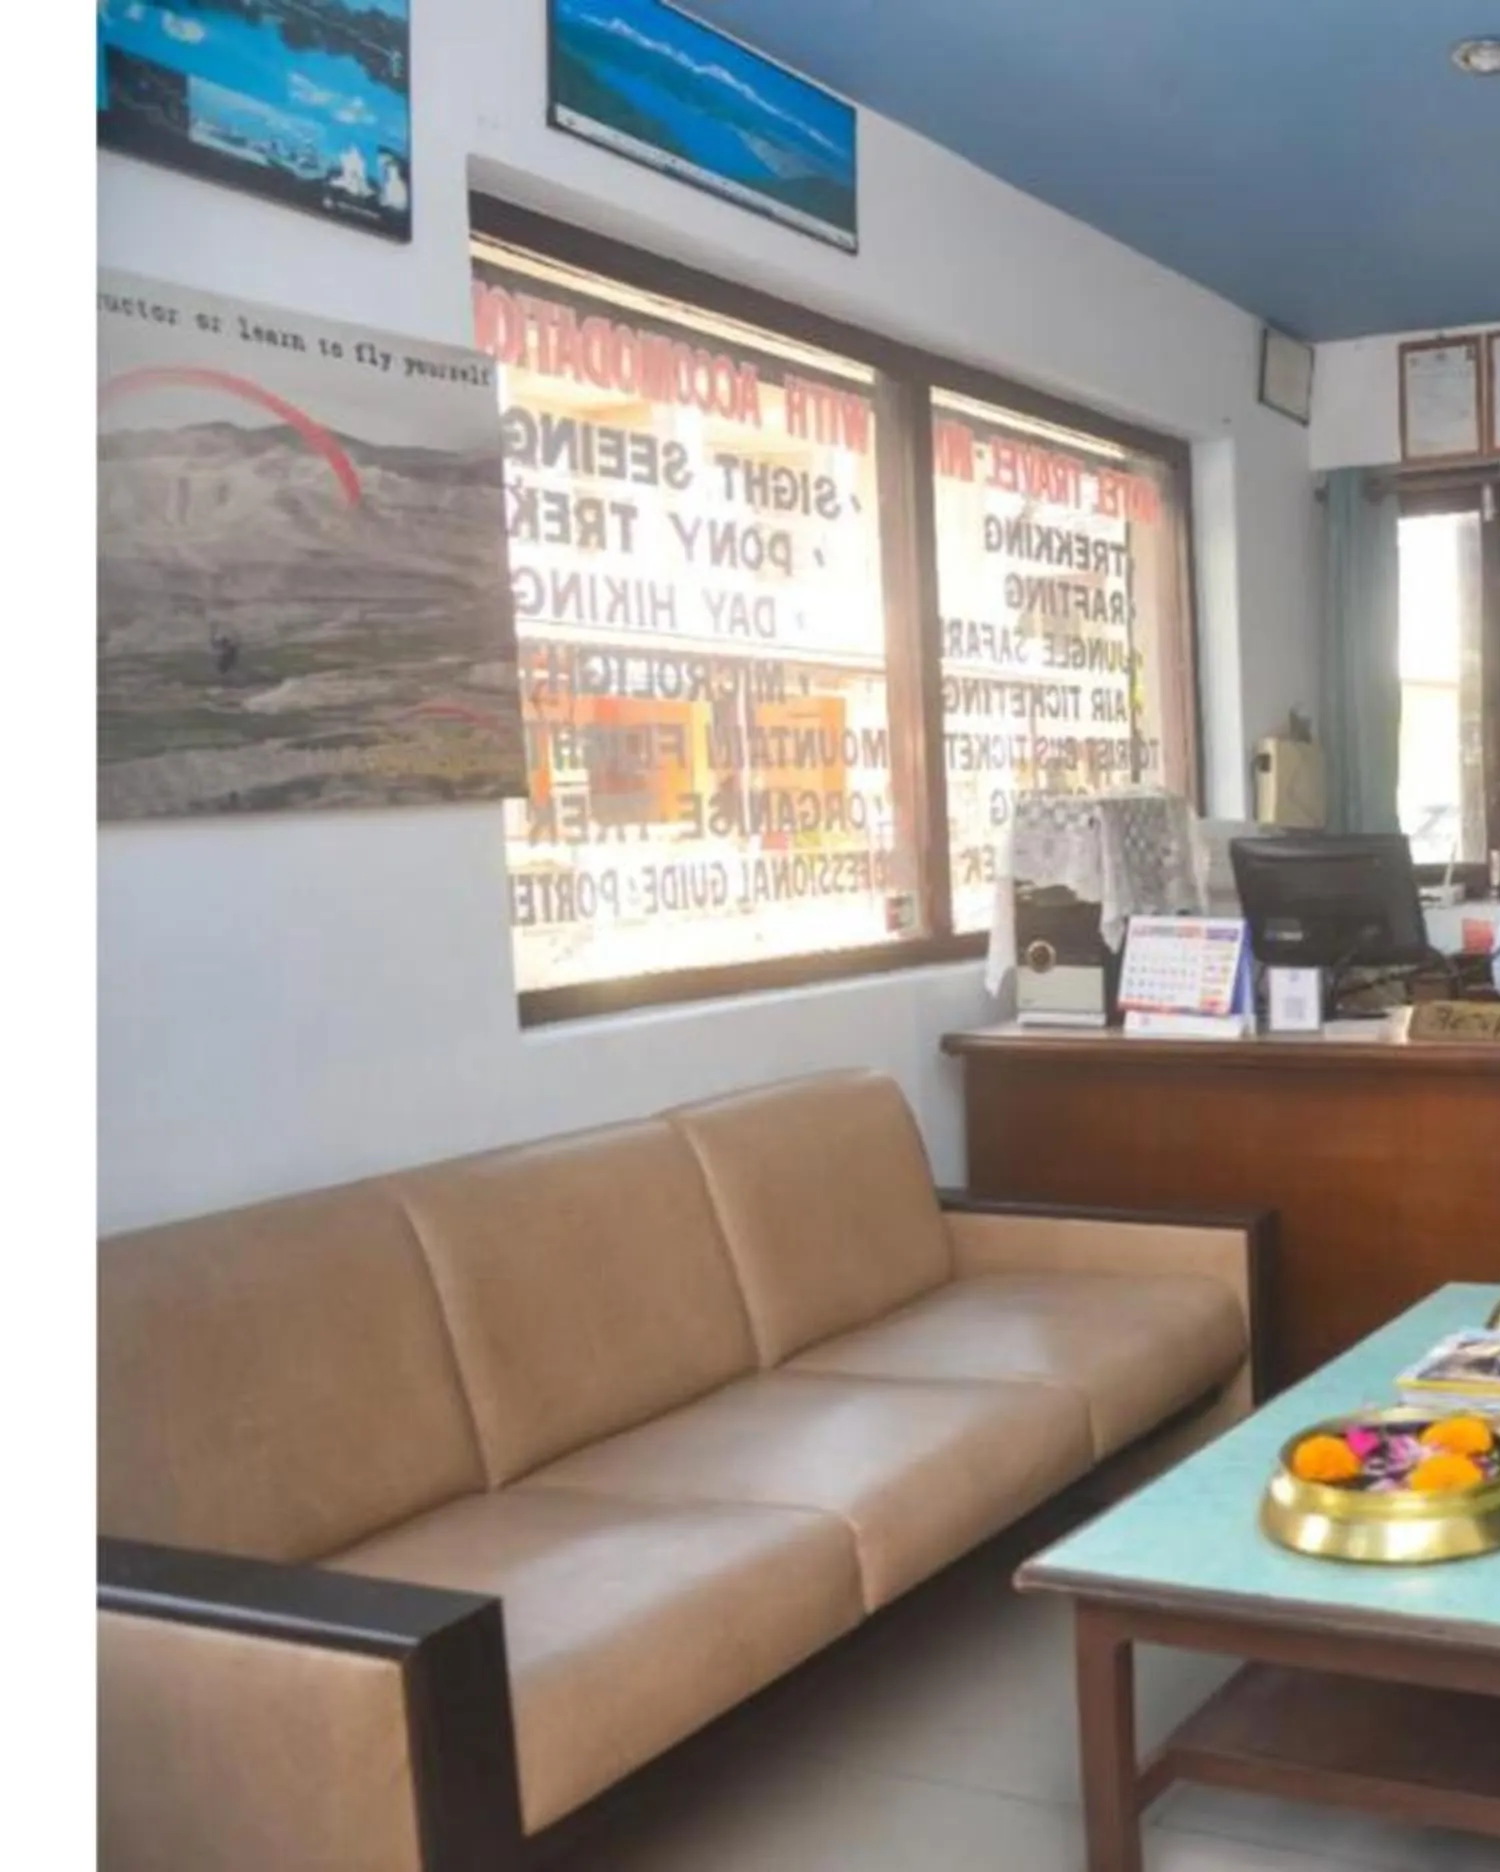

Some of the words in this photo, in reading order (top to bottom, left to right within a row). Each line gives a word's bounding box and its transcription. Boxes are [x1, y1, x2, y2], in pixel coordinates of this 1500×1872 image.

[195, 312, 222, 334] or
[239, 316, 306, 352] learn
[318, 338, 343, 360] to
[354, 341, 392, 372] fly
[402, 354, 494, 388] yourself
